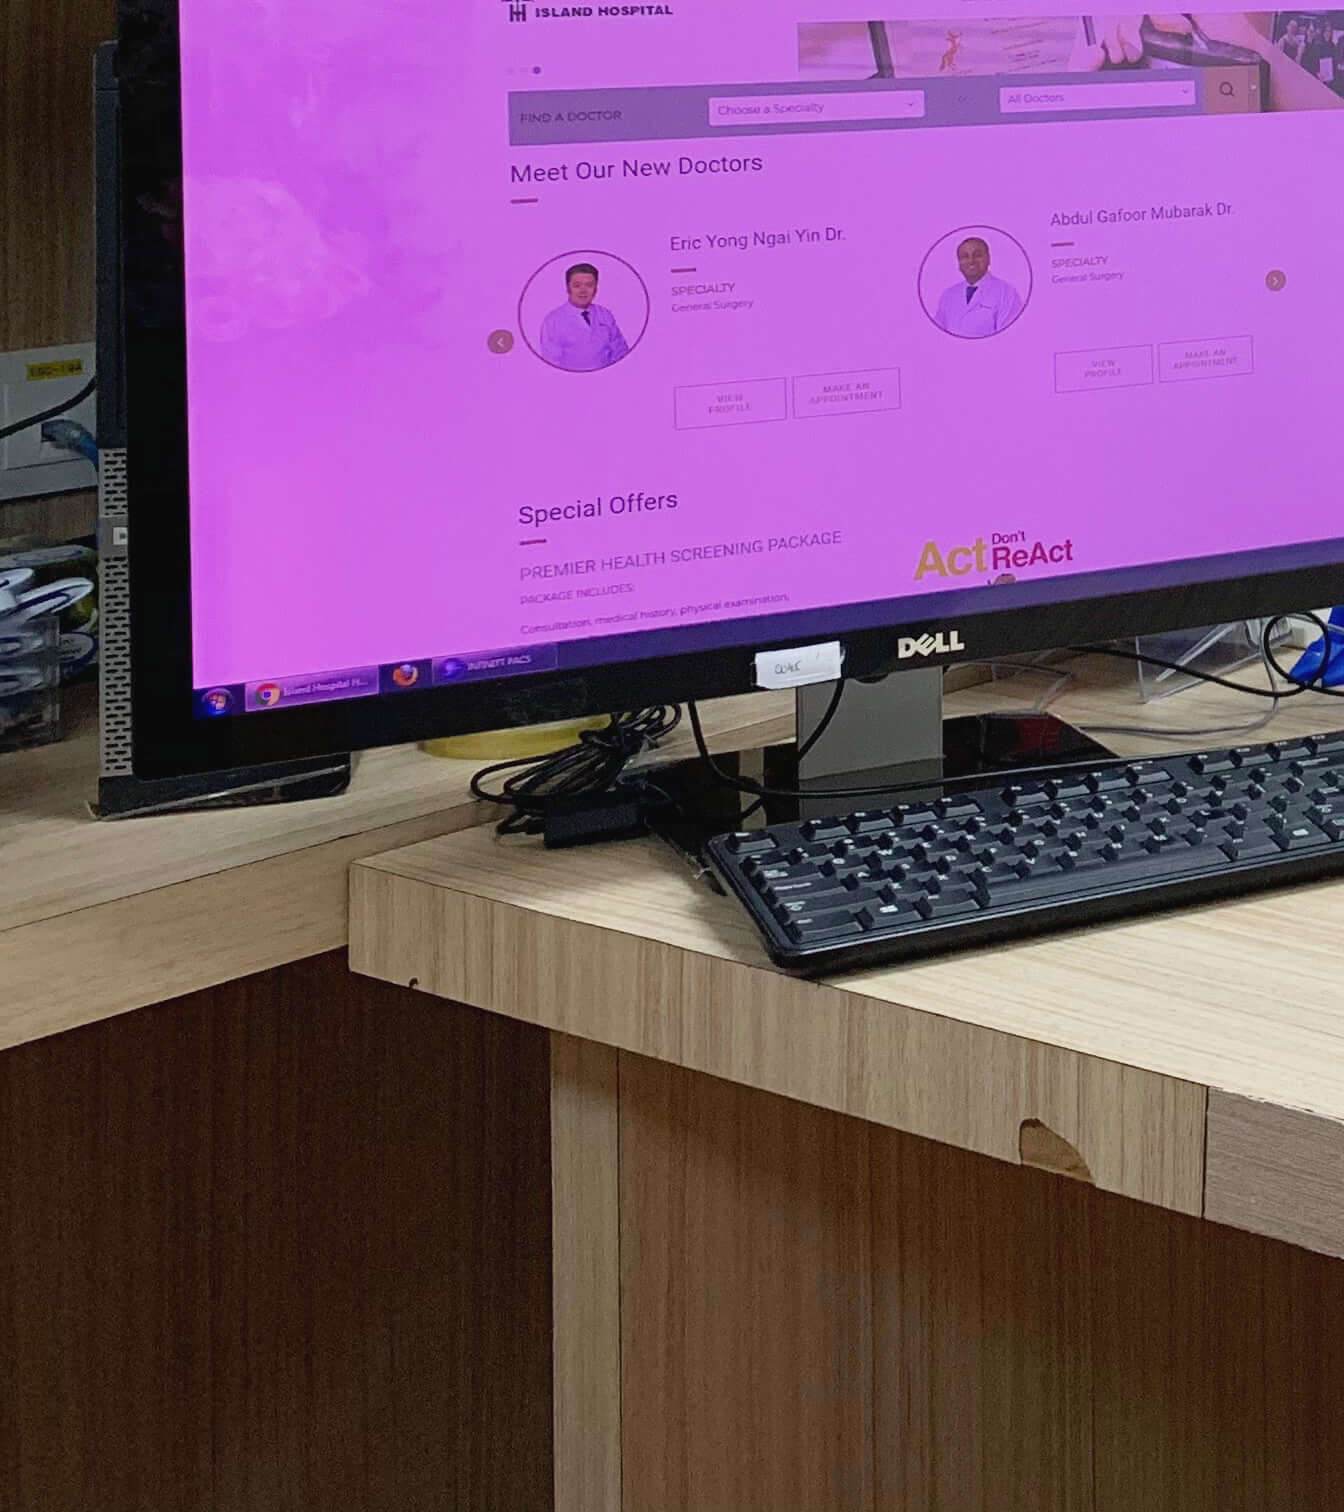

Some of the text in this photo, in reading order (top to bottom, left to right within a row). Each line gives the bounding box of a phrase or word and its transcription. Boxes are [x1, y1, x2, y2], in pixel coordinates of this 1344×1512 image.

[535, 4, 674, 18] ISLAND HOSPITAL
[718, 105, 761, 116] Choose
[772, 102, 825, 115] Specialty
[1024, 92, 1065, 104] Doctors
[519, 109, 623, 124] FIND A DOCTOR
[511, 155, 764, 184] Meet Our New Doctors
[1050, 202, 1213, 227] Abdul Gafoor Mubarak
[670, 226, 847, 252] Eric Yong Ngai Yin Dr.
[1051, 255, 1109, 269] SPECIALTY
[1051, 270, 1125, 284] General Surgery
[671, 282, 736, 297] SPECIALTY
[671, 298, 754, 313] General Surgery
[519, 492, 679, 527] Special Offers
[991, 530, 1026, 545] Don't
[520, 530, 843, 582] PREMIER HEALTH SCREENING PACKAGE
[913, 536, 988, 581] Act
[992, 539, 1074, 570] ReAct
[520, 582, 635, 606] PACKAGE INCLUDES:
[595, 610, 638, 625] medical
[680, 599, 722, 616] physical
[898, 630, 965, 659] DELL
